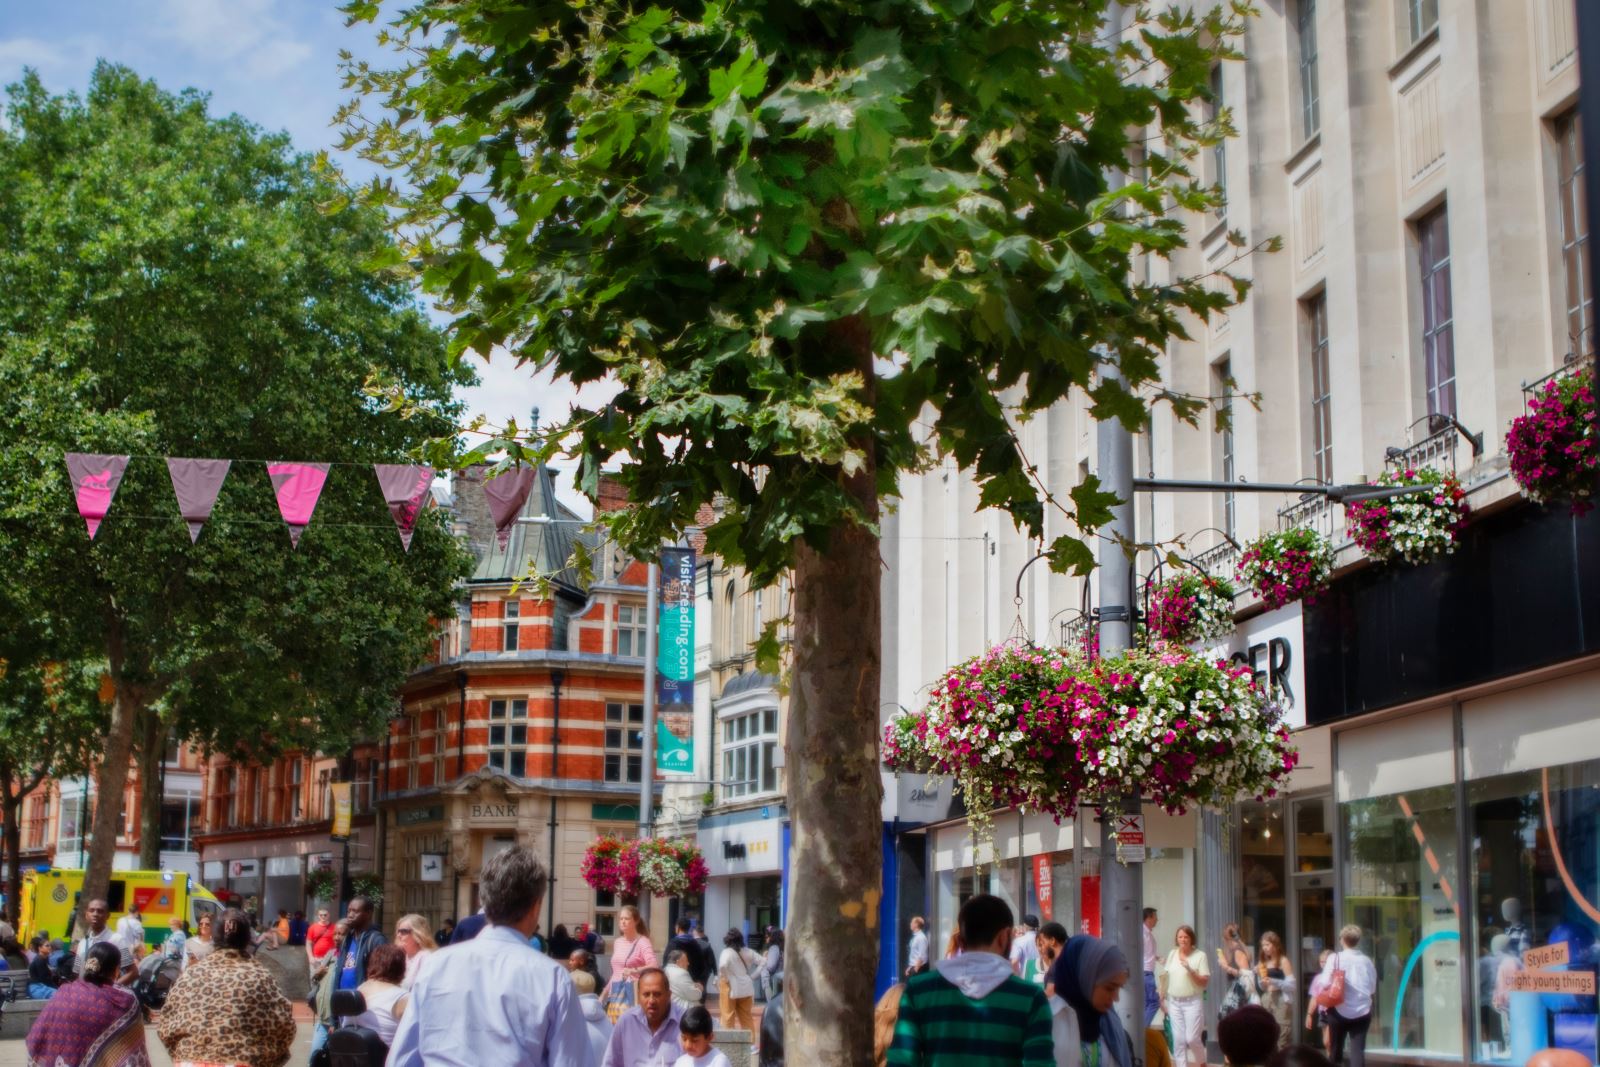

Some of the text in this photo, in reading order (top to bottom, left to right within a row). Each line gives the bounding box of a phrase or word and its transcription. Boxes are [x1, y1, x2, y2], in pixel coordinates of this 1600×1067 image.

[675, 554, 692, 680] visit-reading.com
[471, 805, 517, 818] BANK
[1039, 866, 1051, 881] 50%
[1040, 886, 1051, 901] OFF
[1527, 948, 1564, 969] Style for
[1532, 975, 1560, 991] young
[1562, 974, 1592, 992] things
